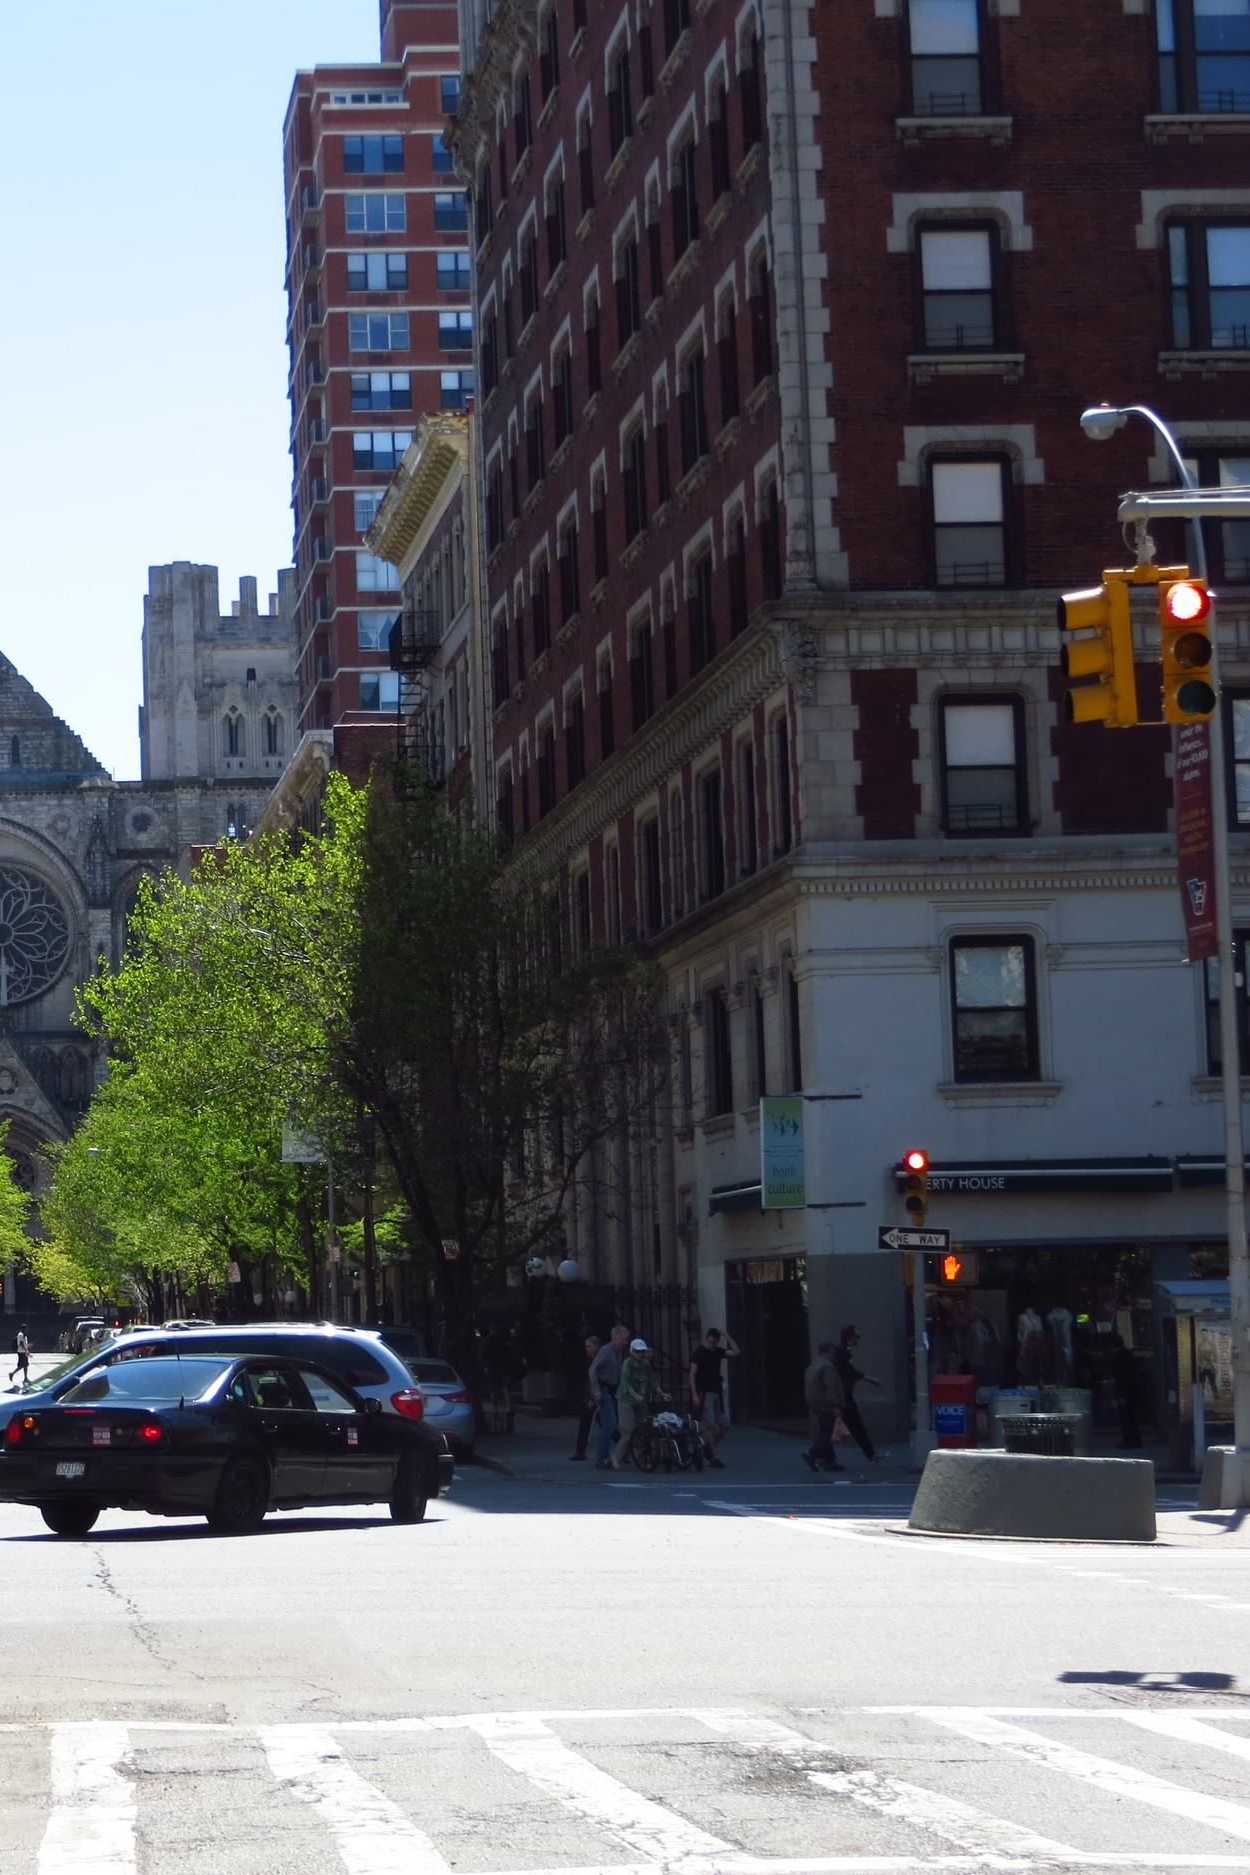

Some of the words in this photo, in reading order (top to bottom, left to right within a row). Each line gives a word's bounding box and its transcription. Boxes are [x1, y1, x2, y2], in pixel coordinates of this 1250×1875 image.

[772, 1164, 797, 1178] book
[767, 1181, 802, 1195] culture
[926, 1177, 955, 1190] ERTY
[959, 1177, 1005, 1190] HOUSE
[888, 1233, 909, 1244] ONE
[919, 1235, 941, 1246] WAY
[935, 1405, 964, 1416] VOICE
